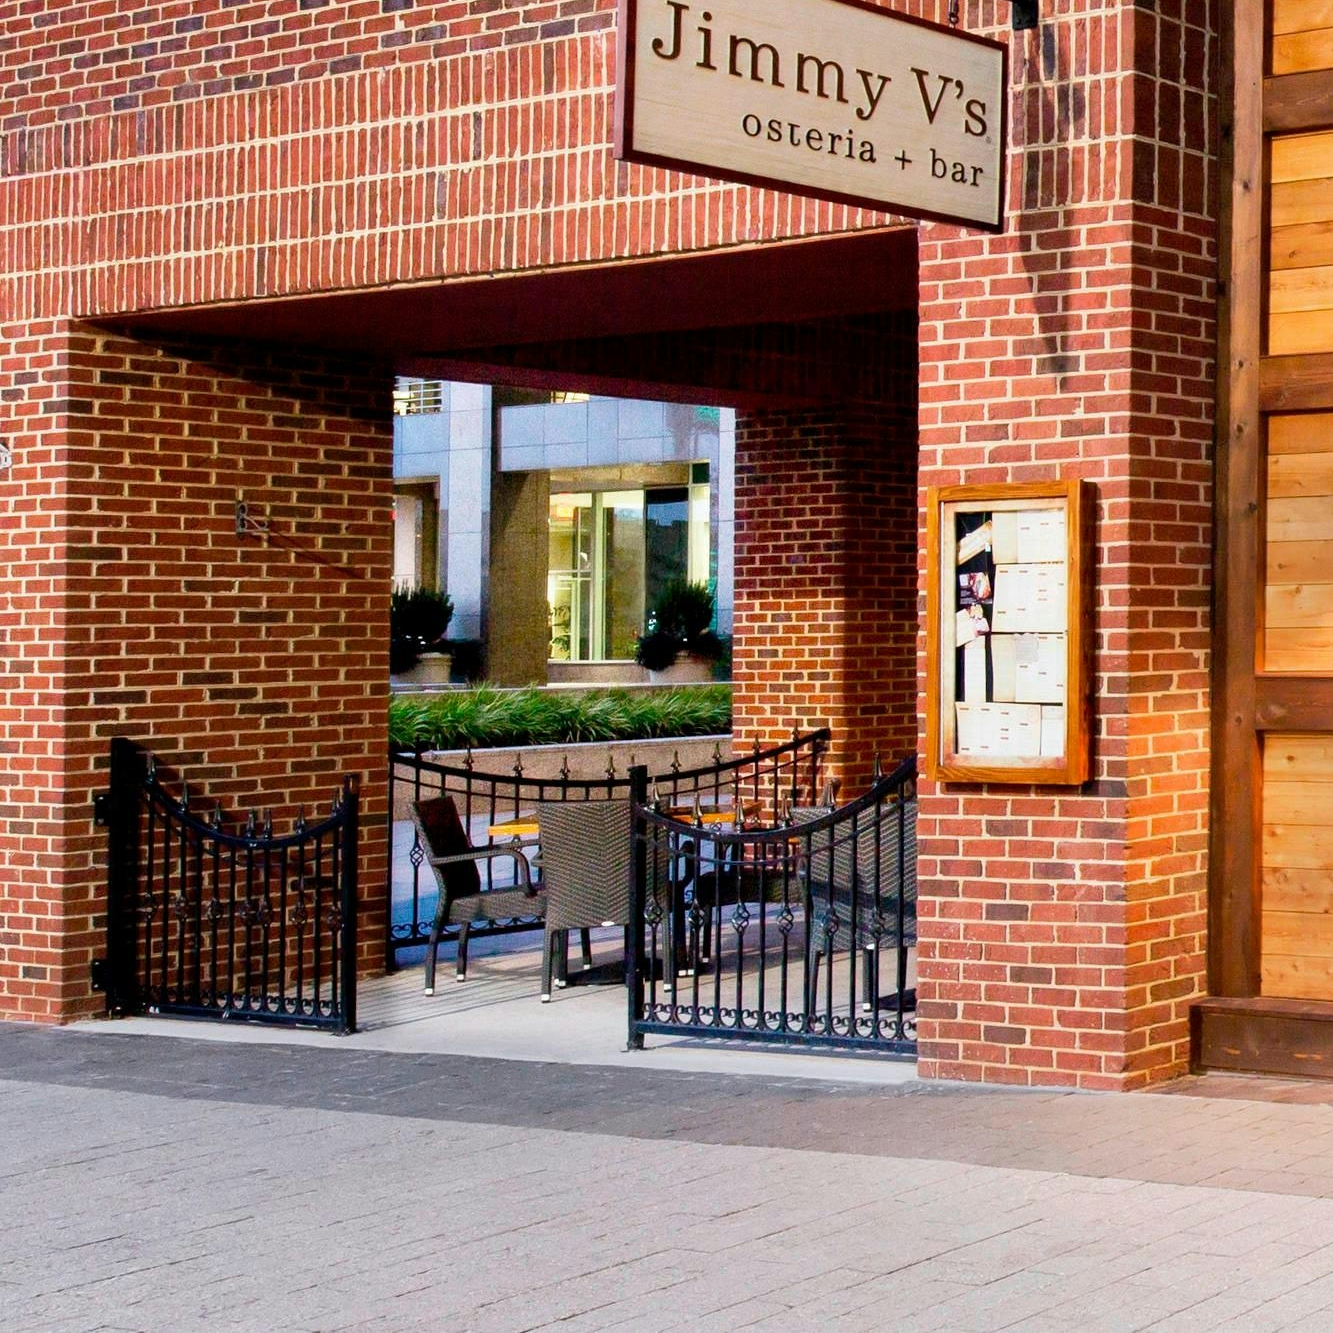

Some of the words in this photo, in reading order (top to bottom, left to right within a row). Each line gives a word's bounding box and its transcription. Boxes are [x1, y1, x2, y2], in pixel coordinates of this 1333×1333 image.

[651, 0, 891, 121] Jimmy
[910, 66, 988, 138] V's
[741, 113, 877, 163] osteria
[894, 150, 913, 171] +
[930, 148, 984, 188] bar
